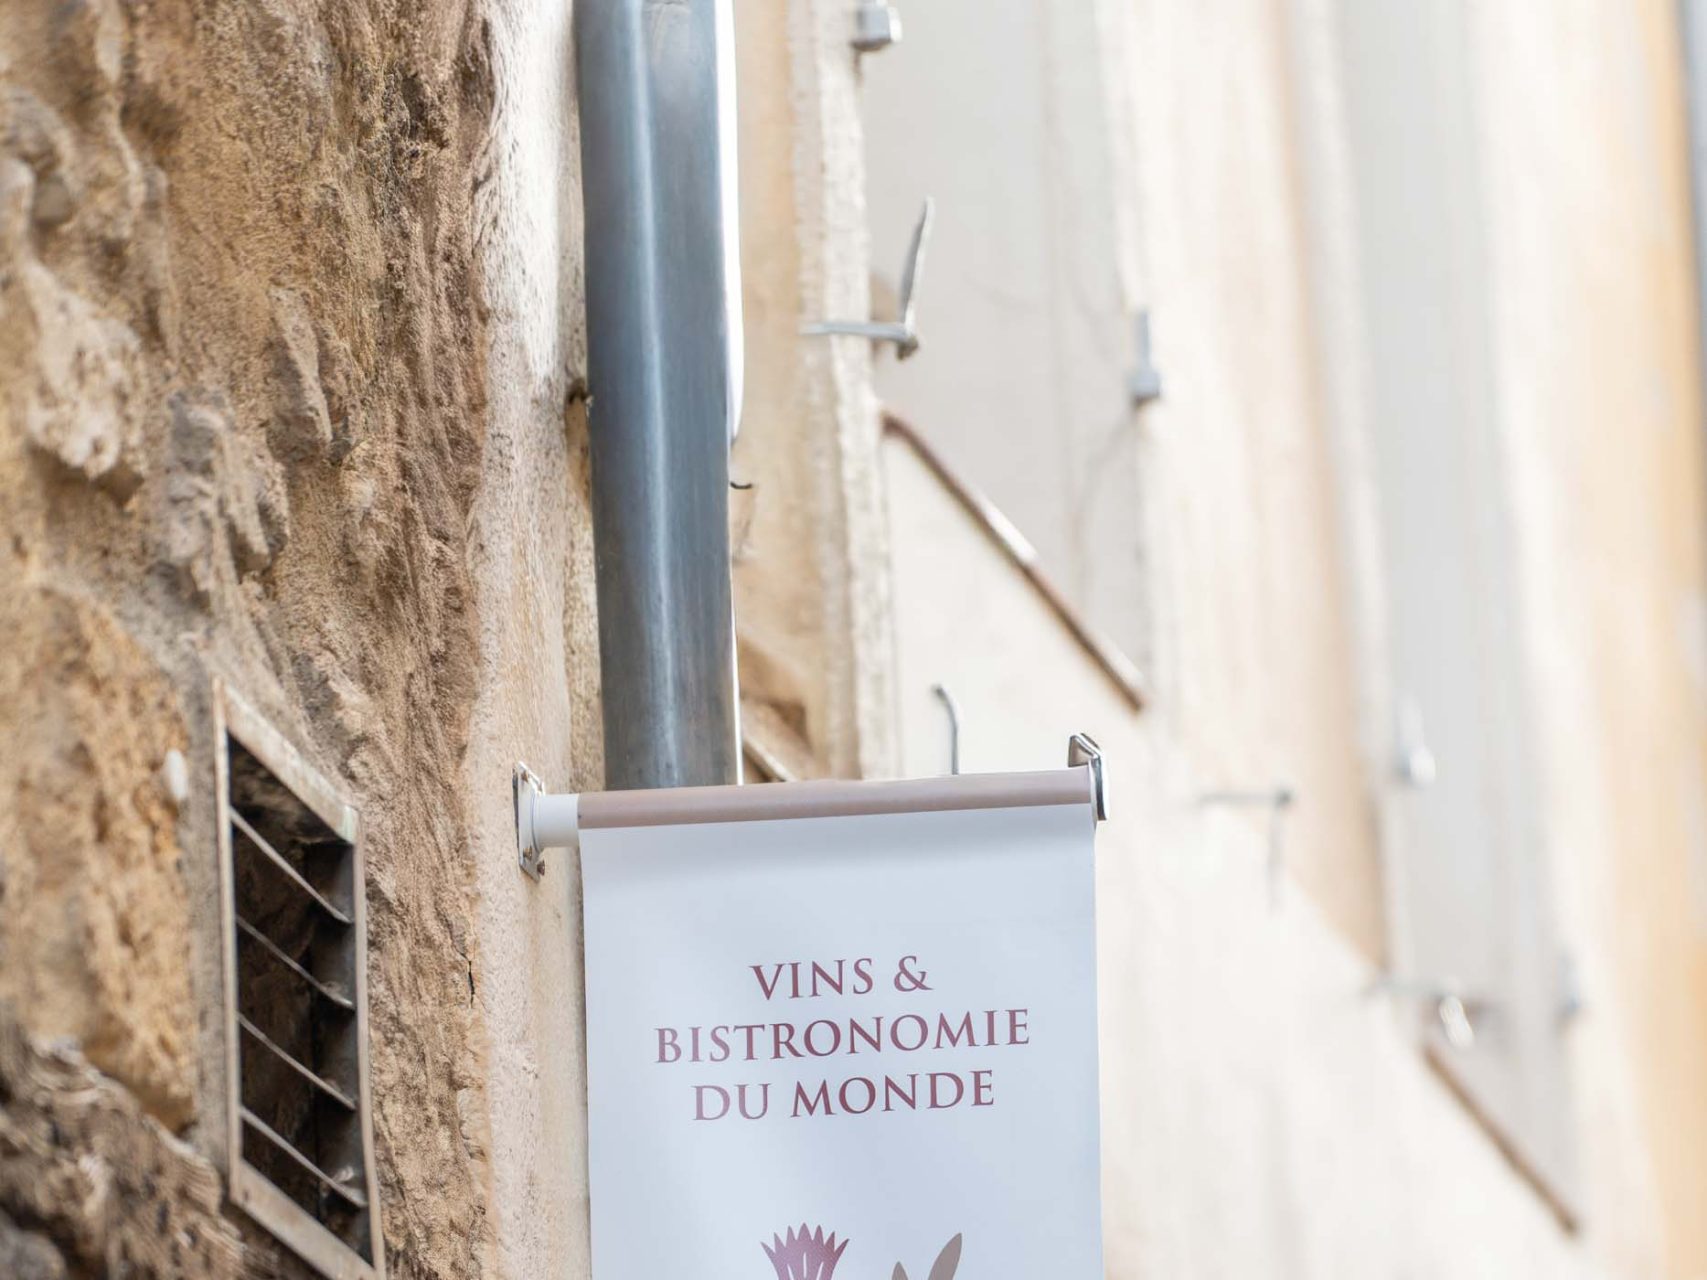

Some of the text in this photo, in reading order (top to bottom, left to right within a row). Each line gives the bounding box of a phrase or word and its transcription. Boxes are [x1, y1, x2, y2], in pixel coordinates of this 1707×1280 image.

[750, 955, 933, 1000] VINS &
[654, 1008, 1030, 1063] BISTRONOMIE
[693, 1069, 994, 1120] DU MONDE
